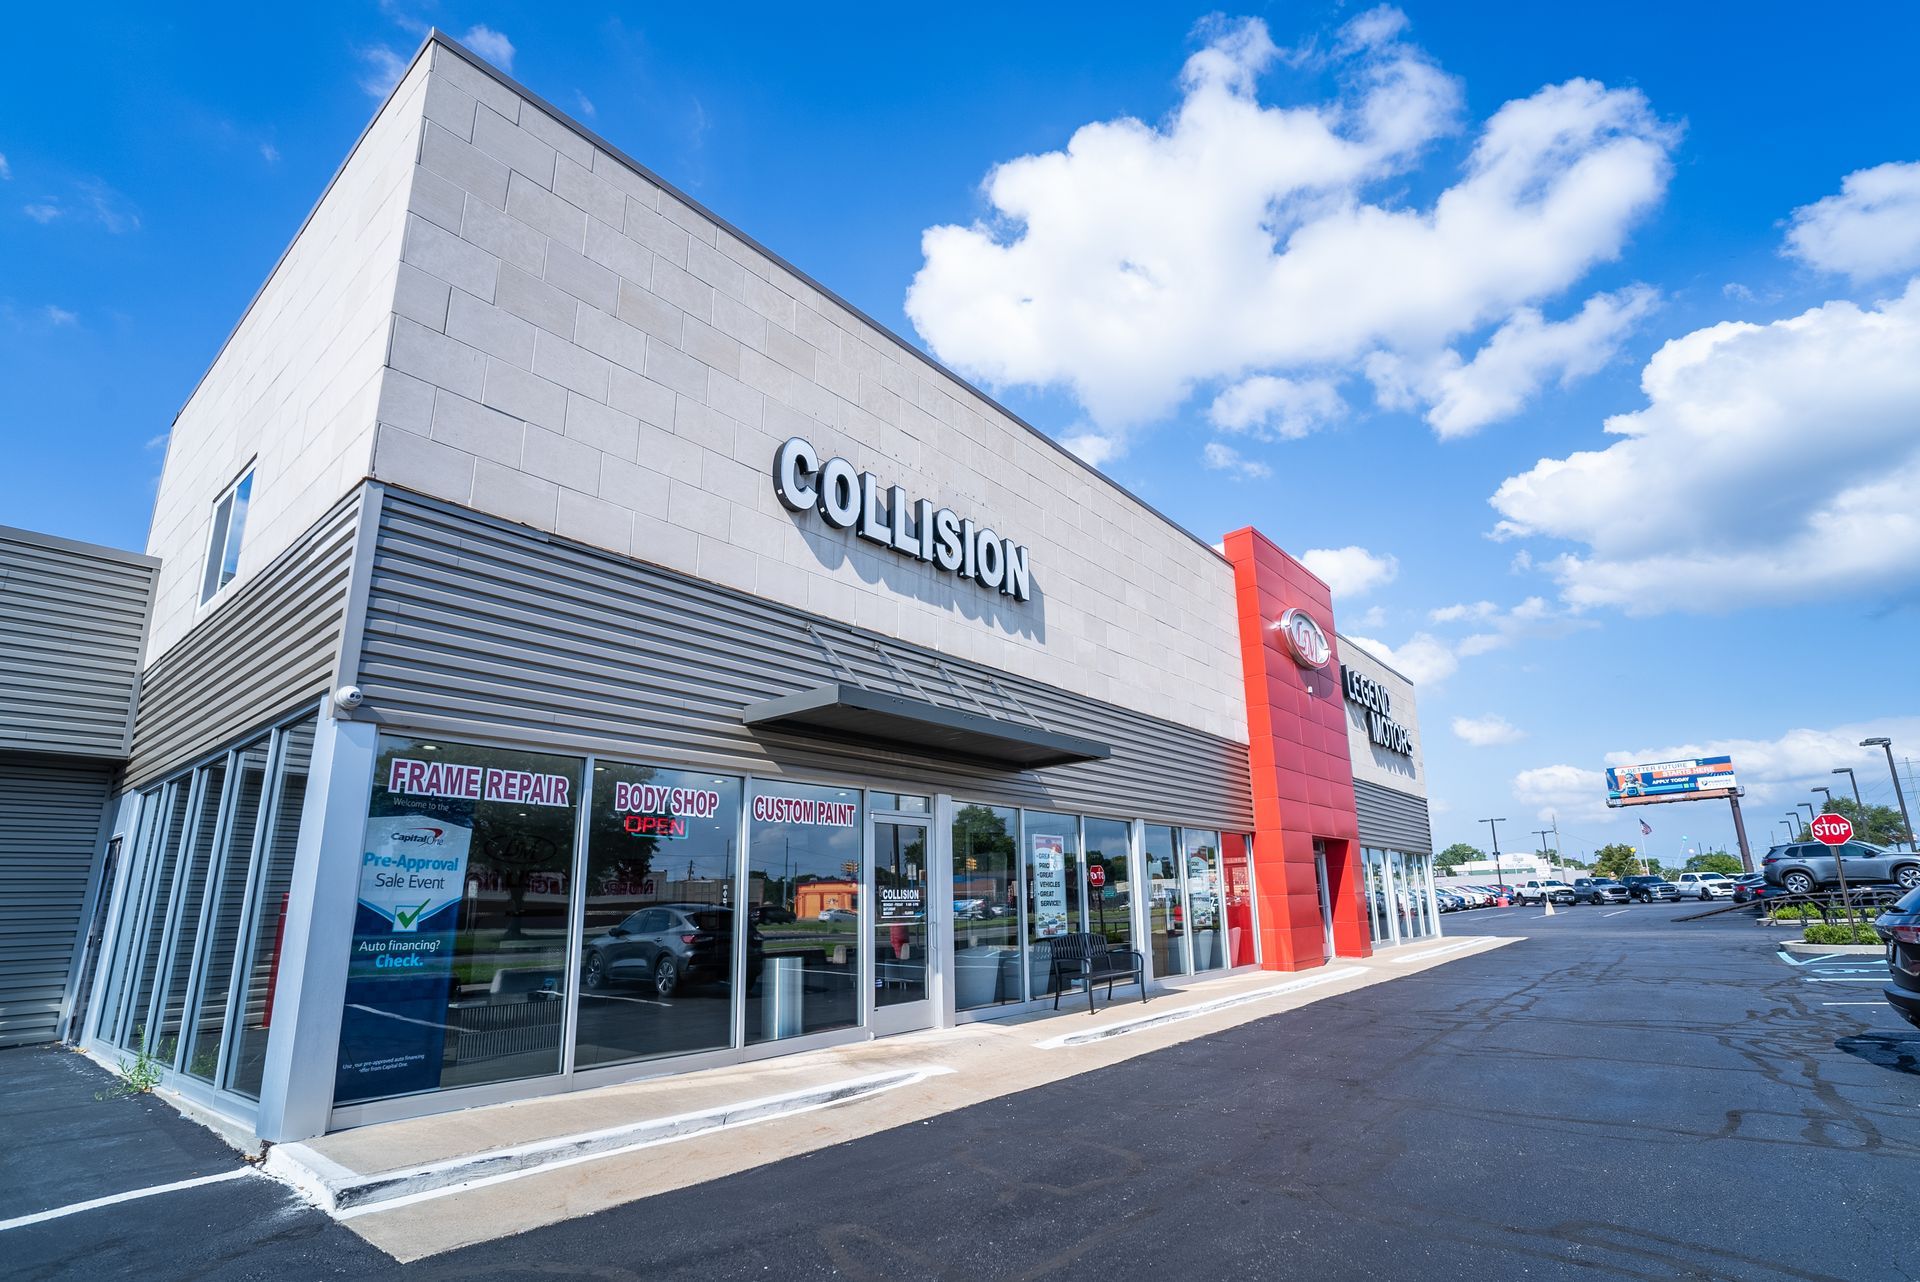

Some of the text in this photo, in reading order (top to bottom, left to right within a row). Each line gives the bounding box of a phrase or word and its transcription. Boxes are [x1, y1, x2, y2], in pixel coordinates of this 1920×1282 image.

[773, 437, 1029, 601] COLLISION
[1341, 664, 1391, 715] LEGEND
[1366, 711, 1414, 757] MOTORS
[1658, 762, 1688, 770] FUTURE
[388, 758, 570, 808] FRAME REPAIR
[393, 797, 428, 808] Welcome
[437, 803, 450, 812] the
[615, 781, 720, 819] BODY SHOP
[753, 795, 857, 828] CUSTOM PAINT
[624, 815, 686, 837] OPEN
[1814, 823, 1849, 836] STOP
[363, 852, 459, 873] Pre-Approval
[374, 872, 405, 888] Sale
[408, 874, 446, 890] Event
[882, 889, 919, 900] COLLISION
[358, 940, 441, 954] Auto financing?
[375, 953, 424, 968] Check.
[382, 1062, 398, 1070] Capital
